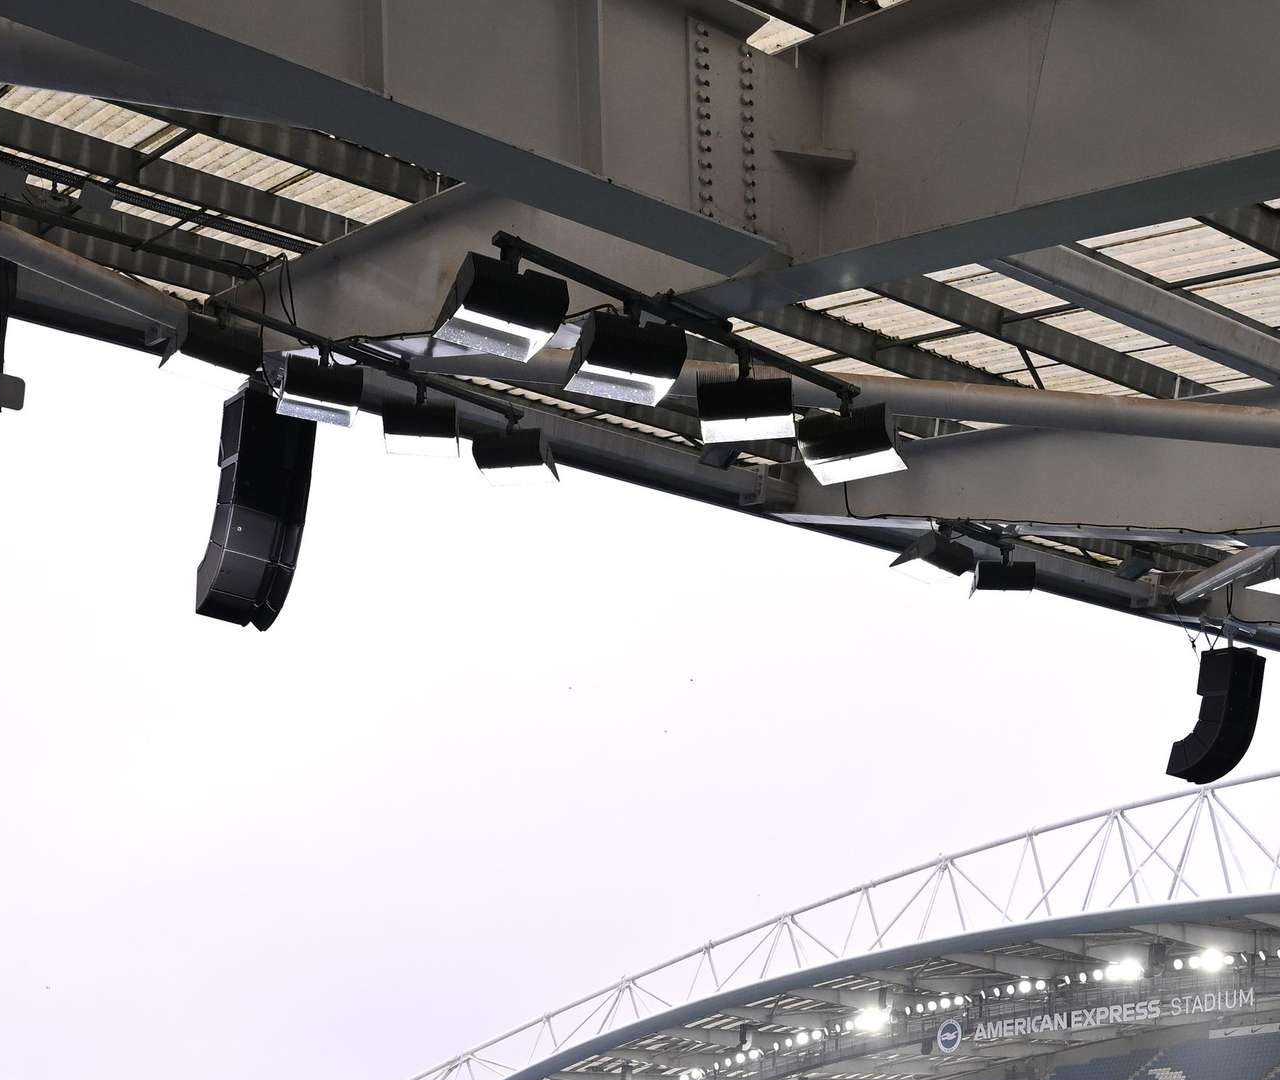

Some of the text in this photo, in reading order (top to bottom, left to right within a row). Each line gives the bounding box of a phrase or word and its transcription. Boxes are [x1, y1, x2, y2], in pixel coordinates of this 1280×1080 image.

[974, 987, 1254, 1041] AMERICAN EXPRESS STADIUM
